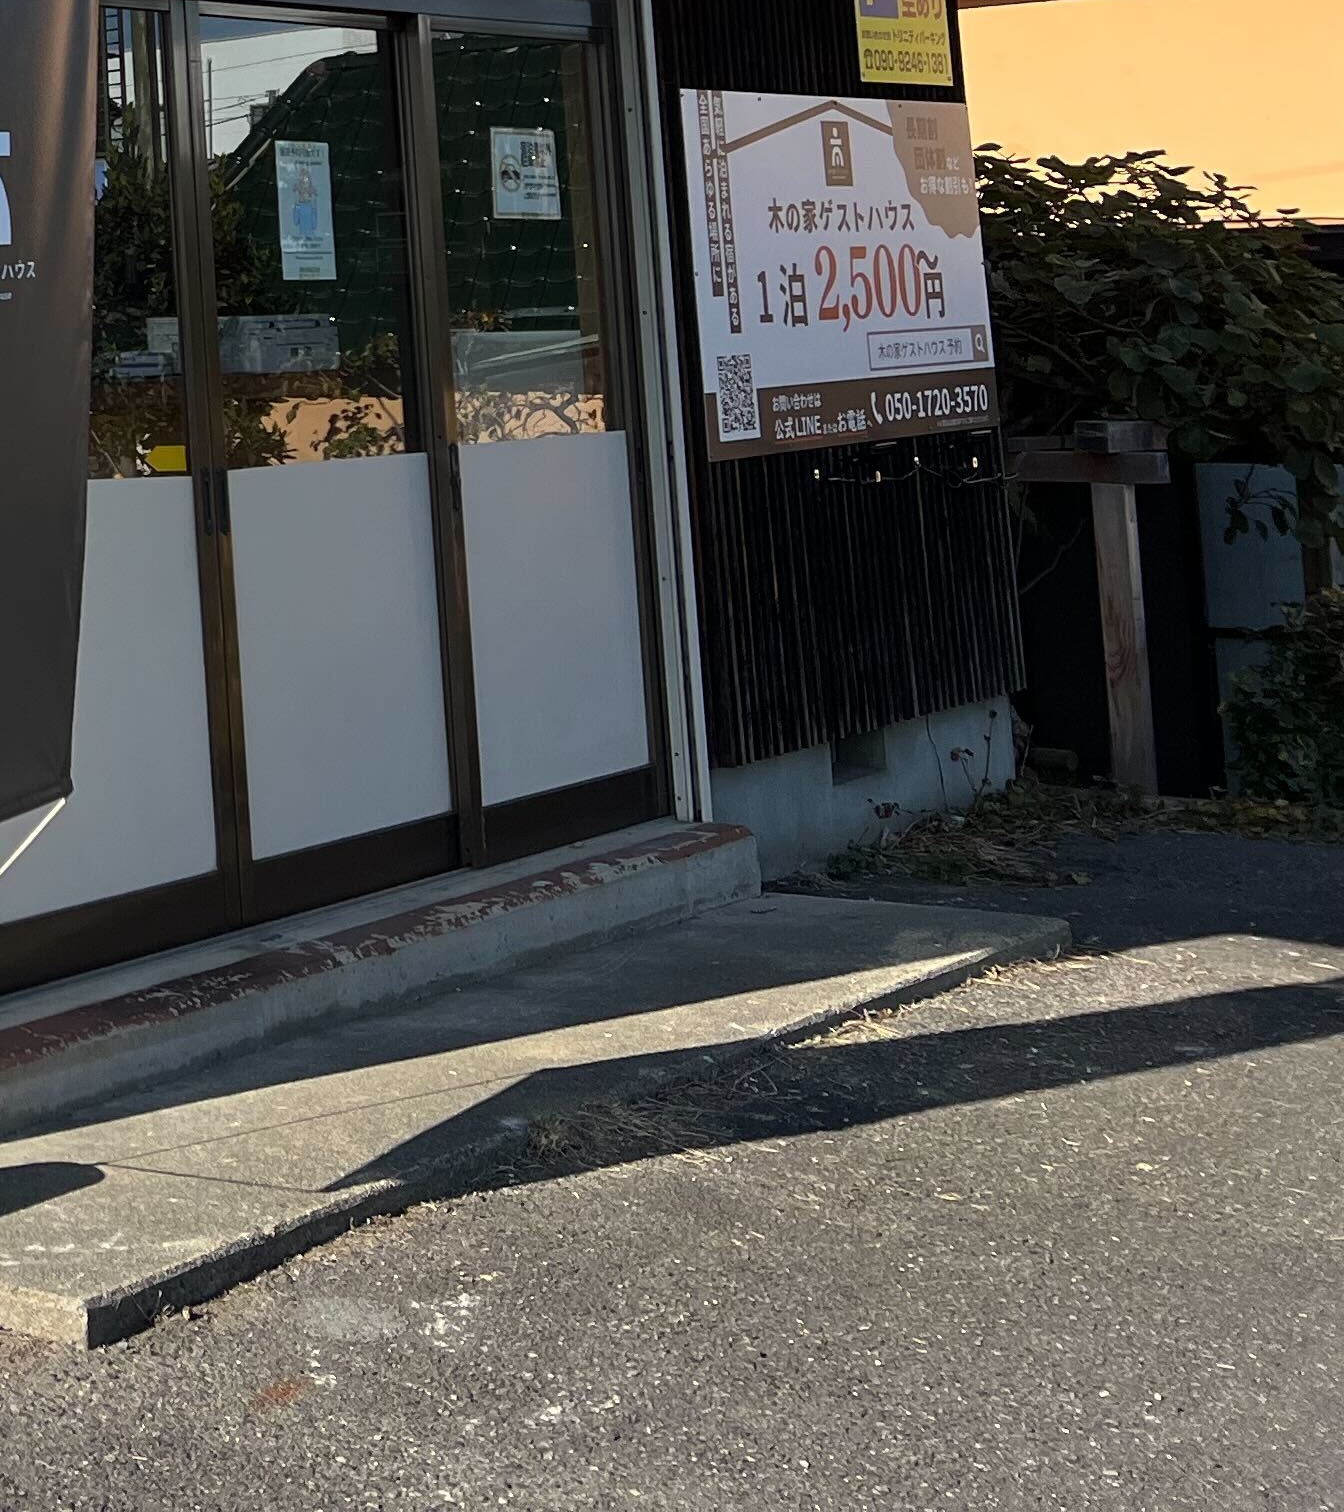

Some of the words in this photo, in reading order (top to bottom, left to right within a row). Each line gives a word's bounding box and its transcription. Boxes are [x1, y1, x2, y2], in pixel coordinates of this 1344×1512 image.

[767, 197, 915, 234] 木の家ゲストハウス
[885, 384, 988, 422] 050-1720-3570
